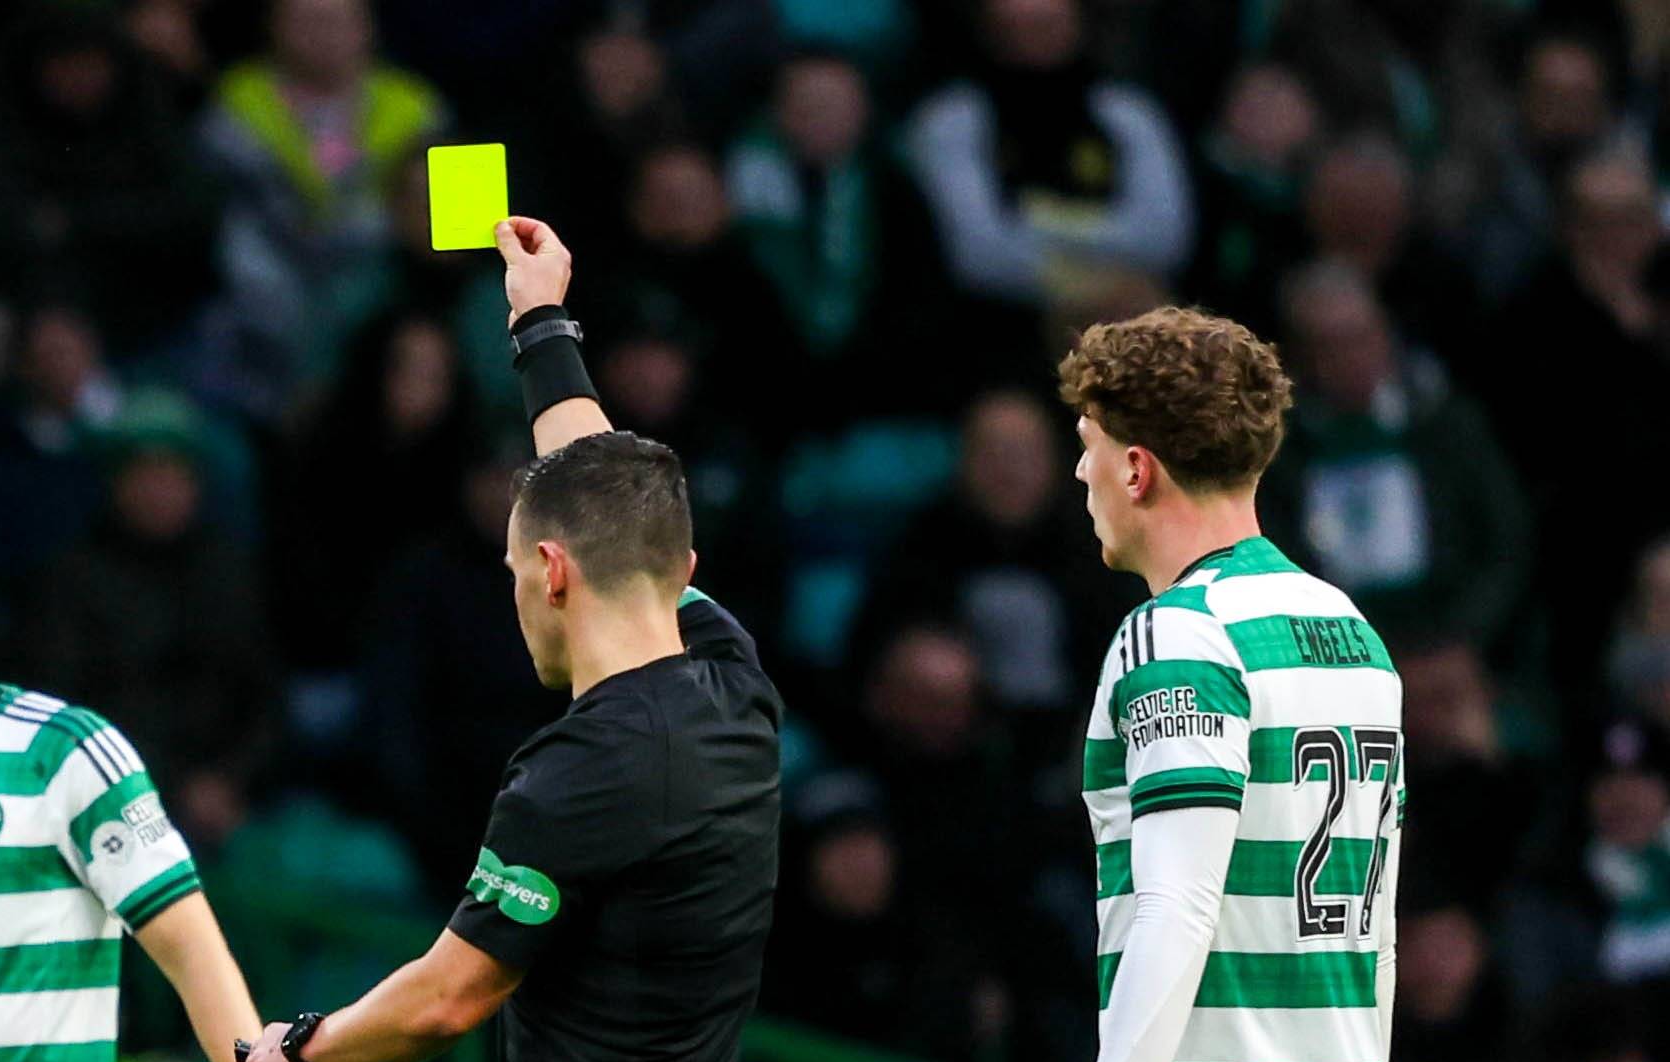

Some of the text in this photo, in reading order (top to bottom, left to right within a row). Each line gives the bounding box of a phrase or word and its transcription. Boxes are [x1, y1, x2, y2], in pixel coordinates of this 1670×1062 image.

[1289, 617, 1370, 664] ENGELS
[1129, 687, 1196, 725] CELTIC FC
[1131, 714, 1224, 752] FOUNDATION
[1294, 725, 1400, 942] 27
